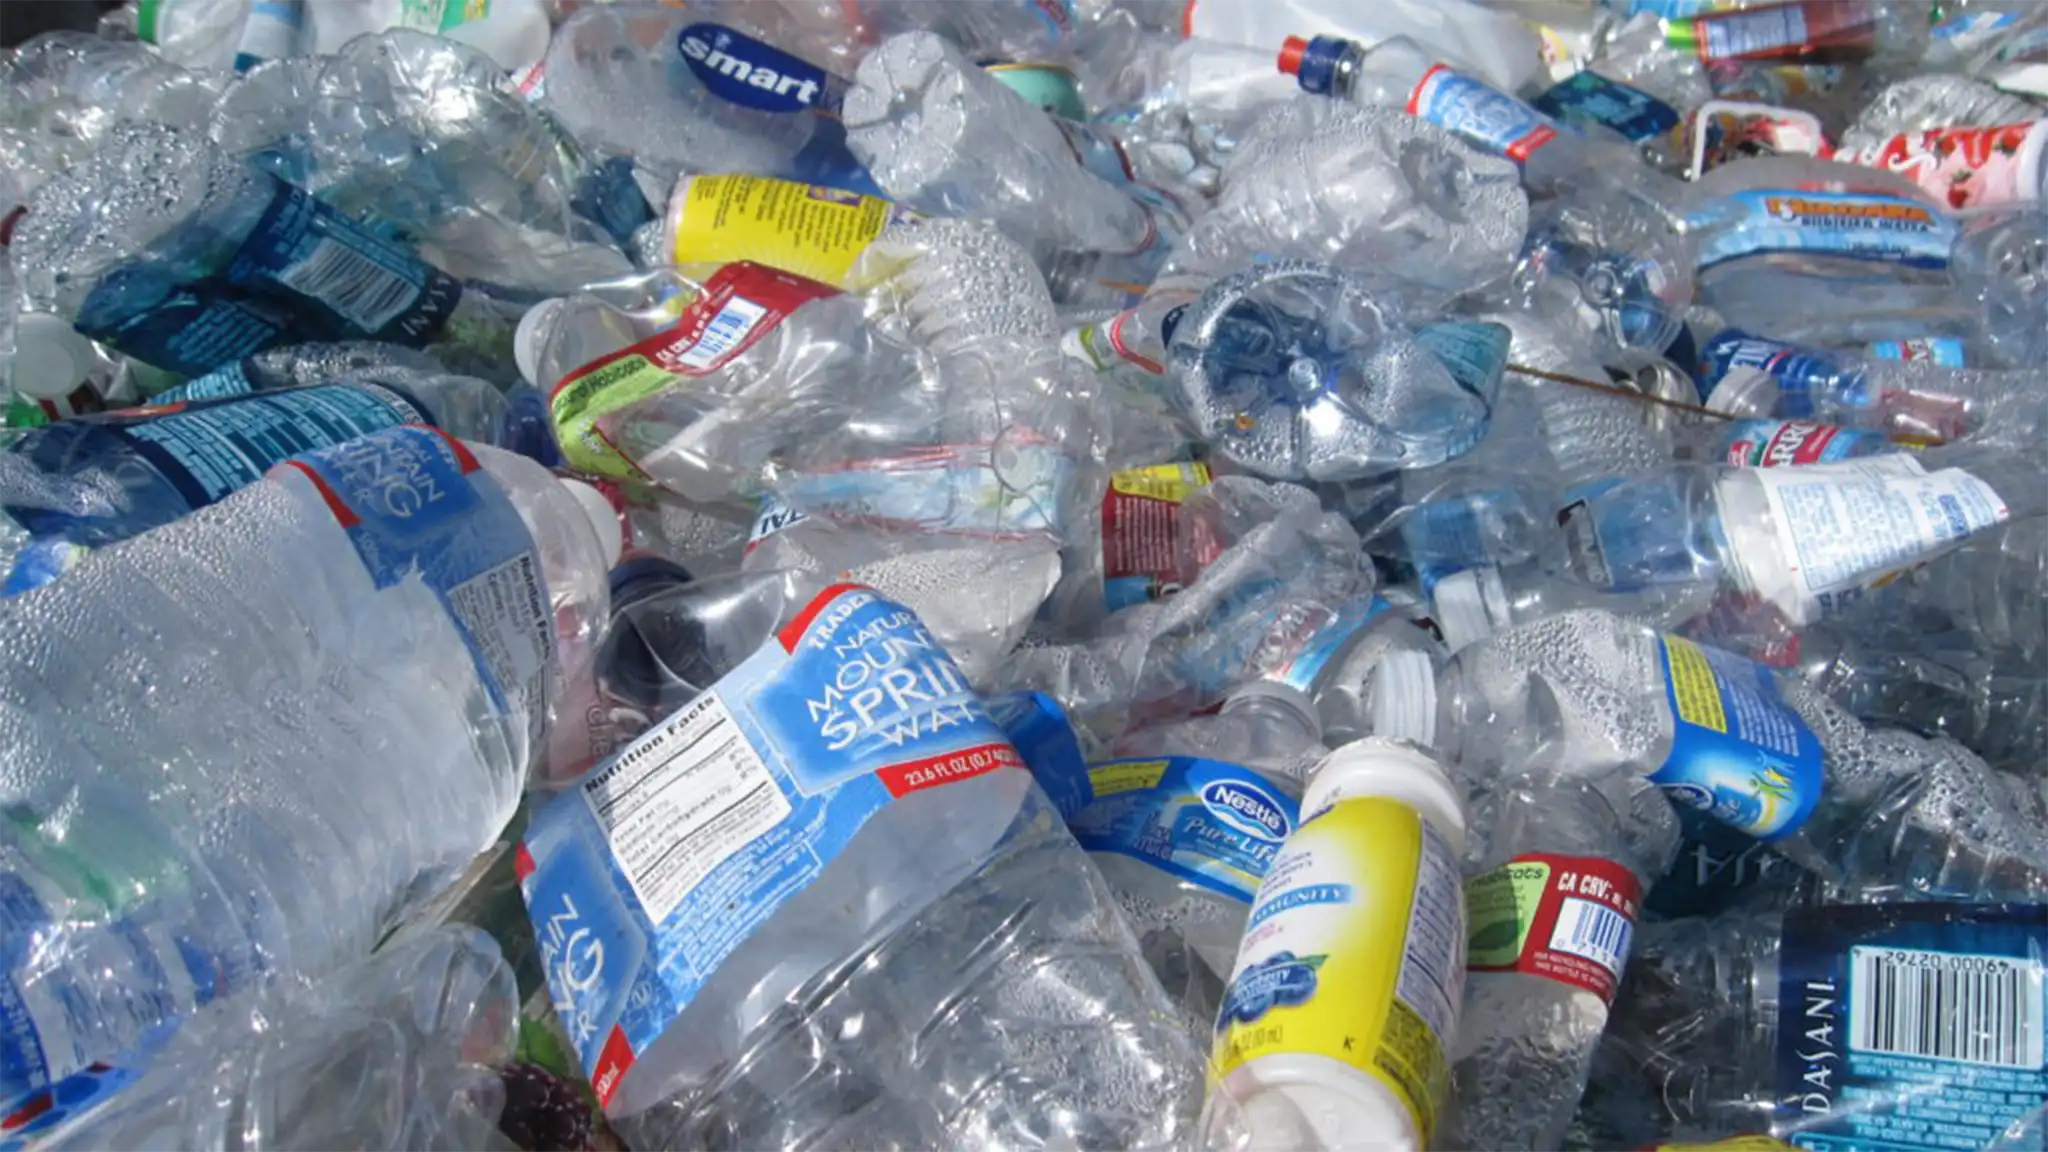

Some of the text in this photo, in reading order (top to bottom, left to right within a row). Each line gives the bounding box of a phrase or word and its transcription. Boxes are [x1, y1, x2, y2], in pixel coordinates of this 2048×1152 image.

[681, 36, 819, 104] smart
[584, 734, 665, 794] Nutrition
[666, 696, 715, 736] Facts
[1556, 871, 1578, 892] CA
[1884, 950, 1942, 970] 02762
[1950, 953, 2010, 977] 49000
[1798, 981, 1841, 1113] DASANI
